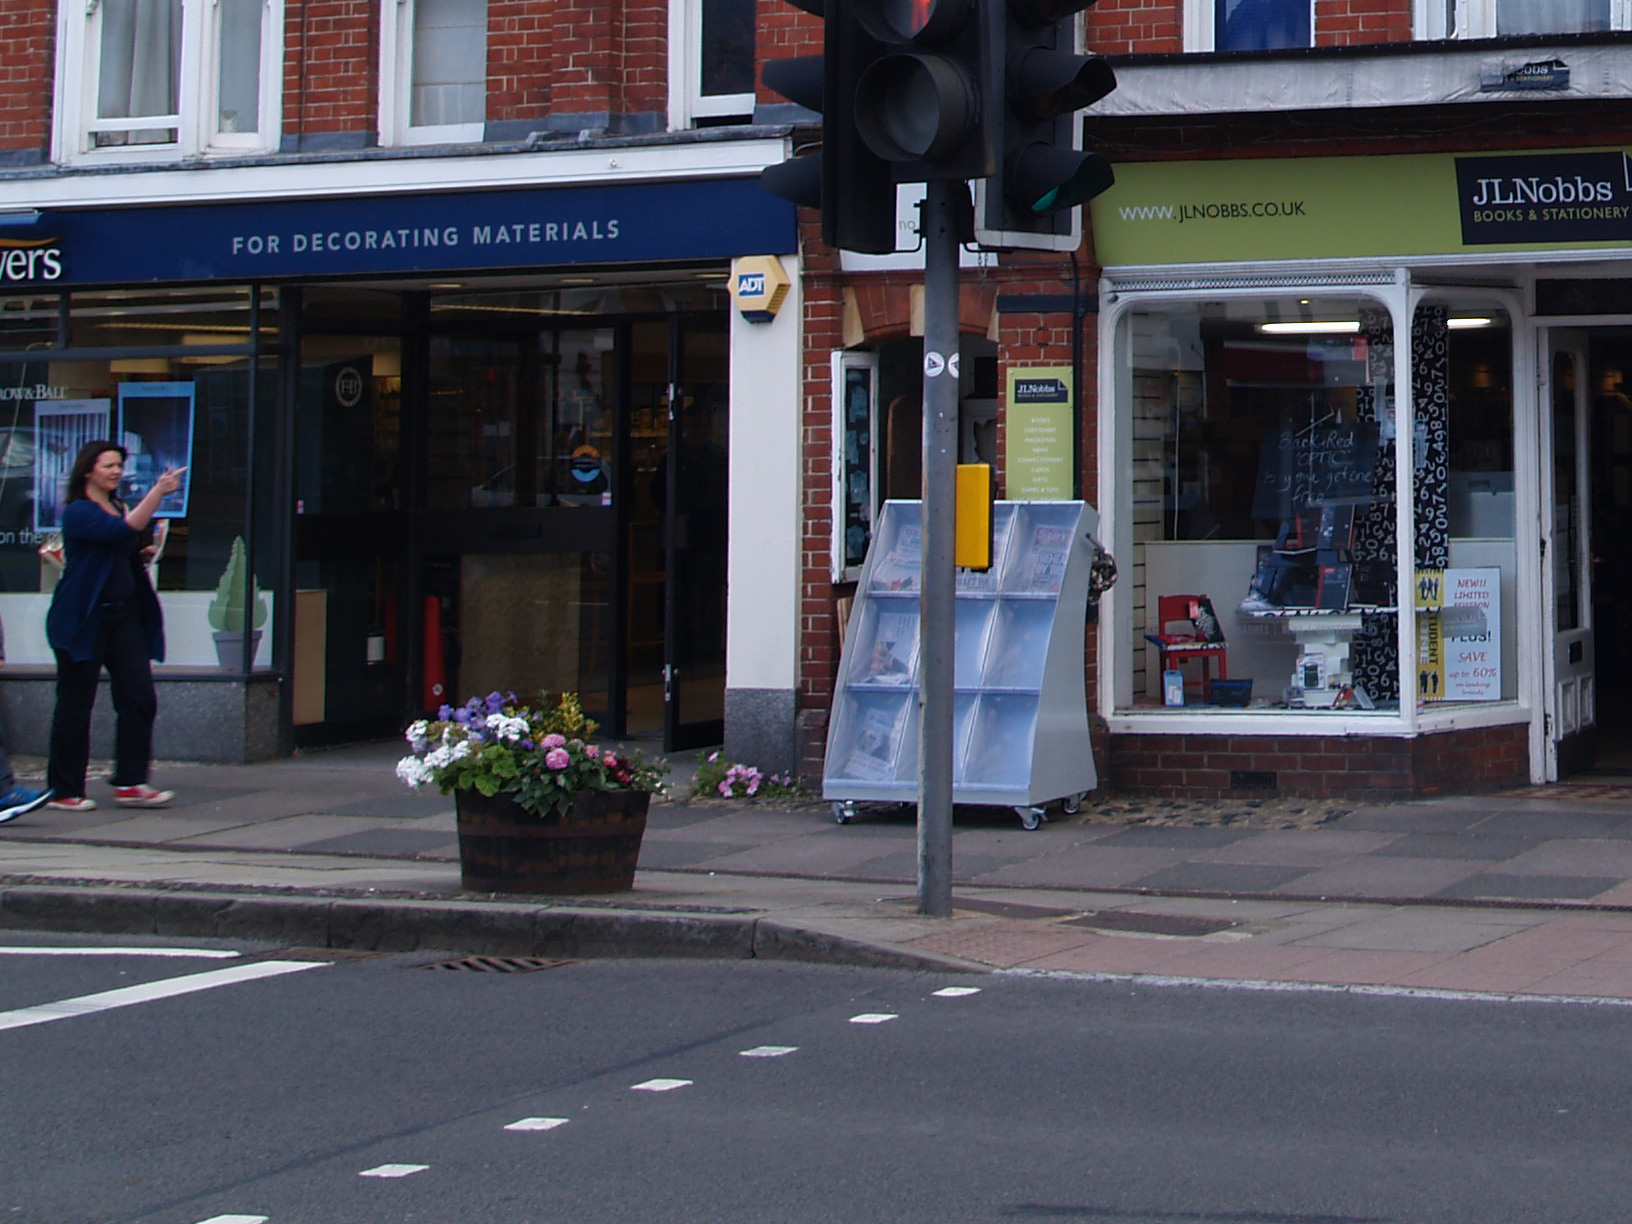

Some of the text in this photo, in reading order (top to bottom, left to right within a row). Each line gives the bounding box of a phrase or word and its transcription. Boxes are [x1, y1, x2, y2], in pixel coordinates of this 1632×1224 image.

[1472, 176, 1613, 206] JLNobbs
[1474, 206, 1630, 222] BOOKS & STATIONERY
[232, 219, 620, 255] FOR DECORATING MATERIALS
[738, 277, 764, 293] ADT
[20, 528, 42, 545] the
[1457, 579, 1487, 588] NEW!!
[1454, 591, 1489, 599] LIMITED
[1428, 613, 1439, 665] TUDENT
[1458, 651, 1487, 663] SAVE
[1472, 667, 1498, 679] 60%
